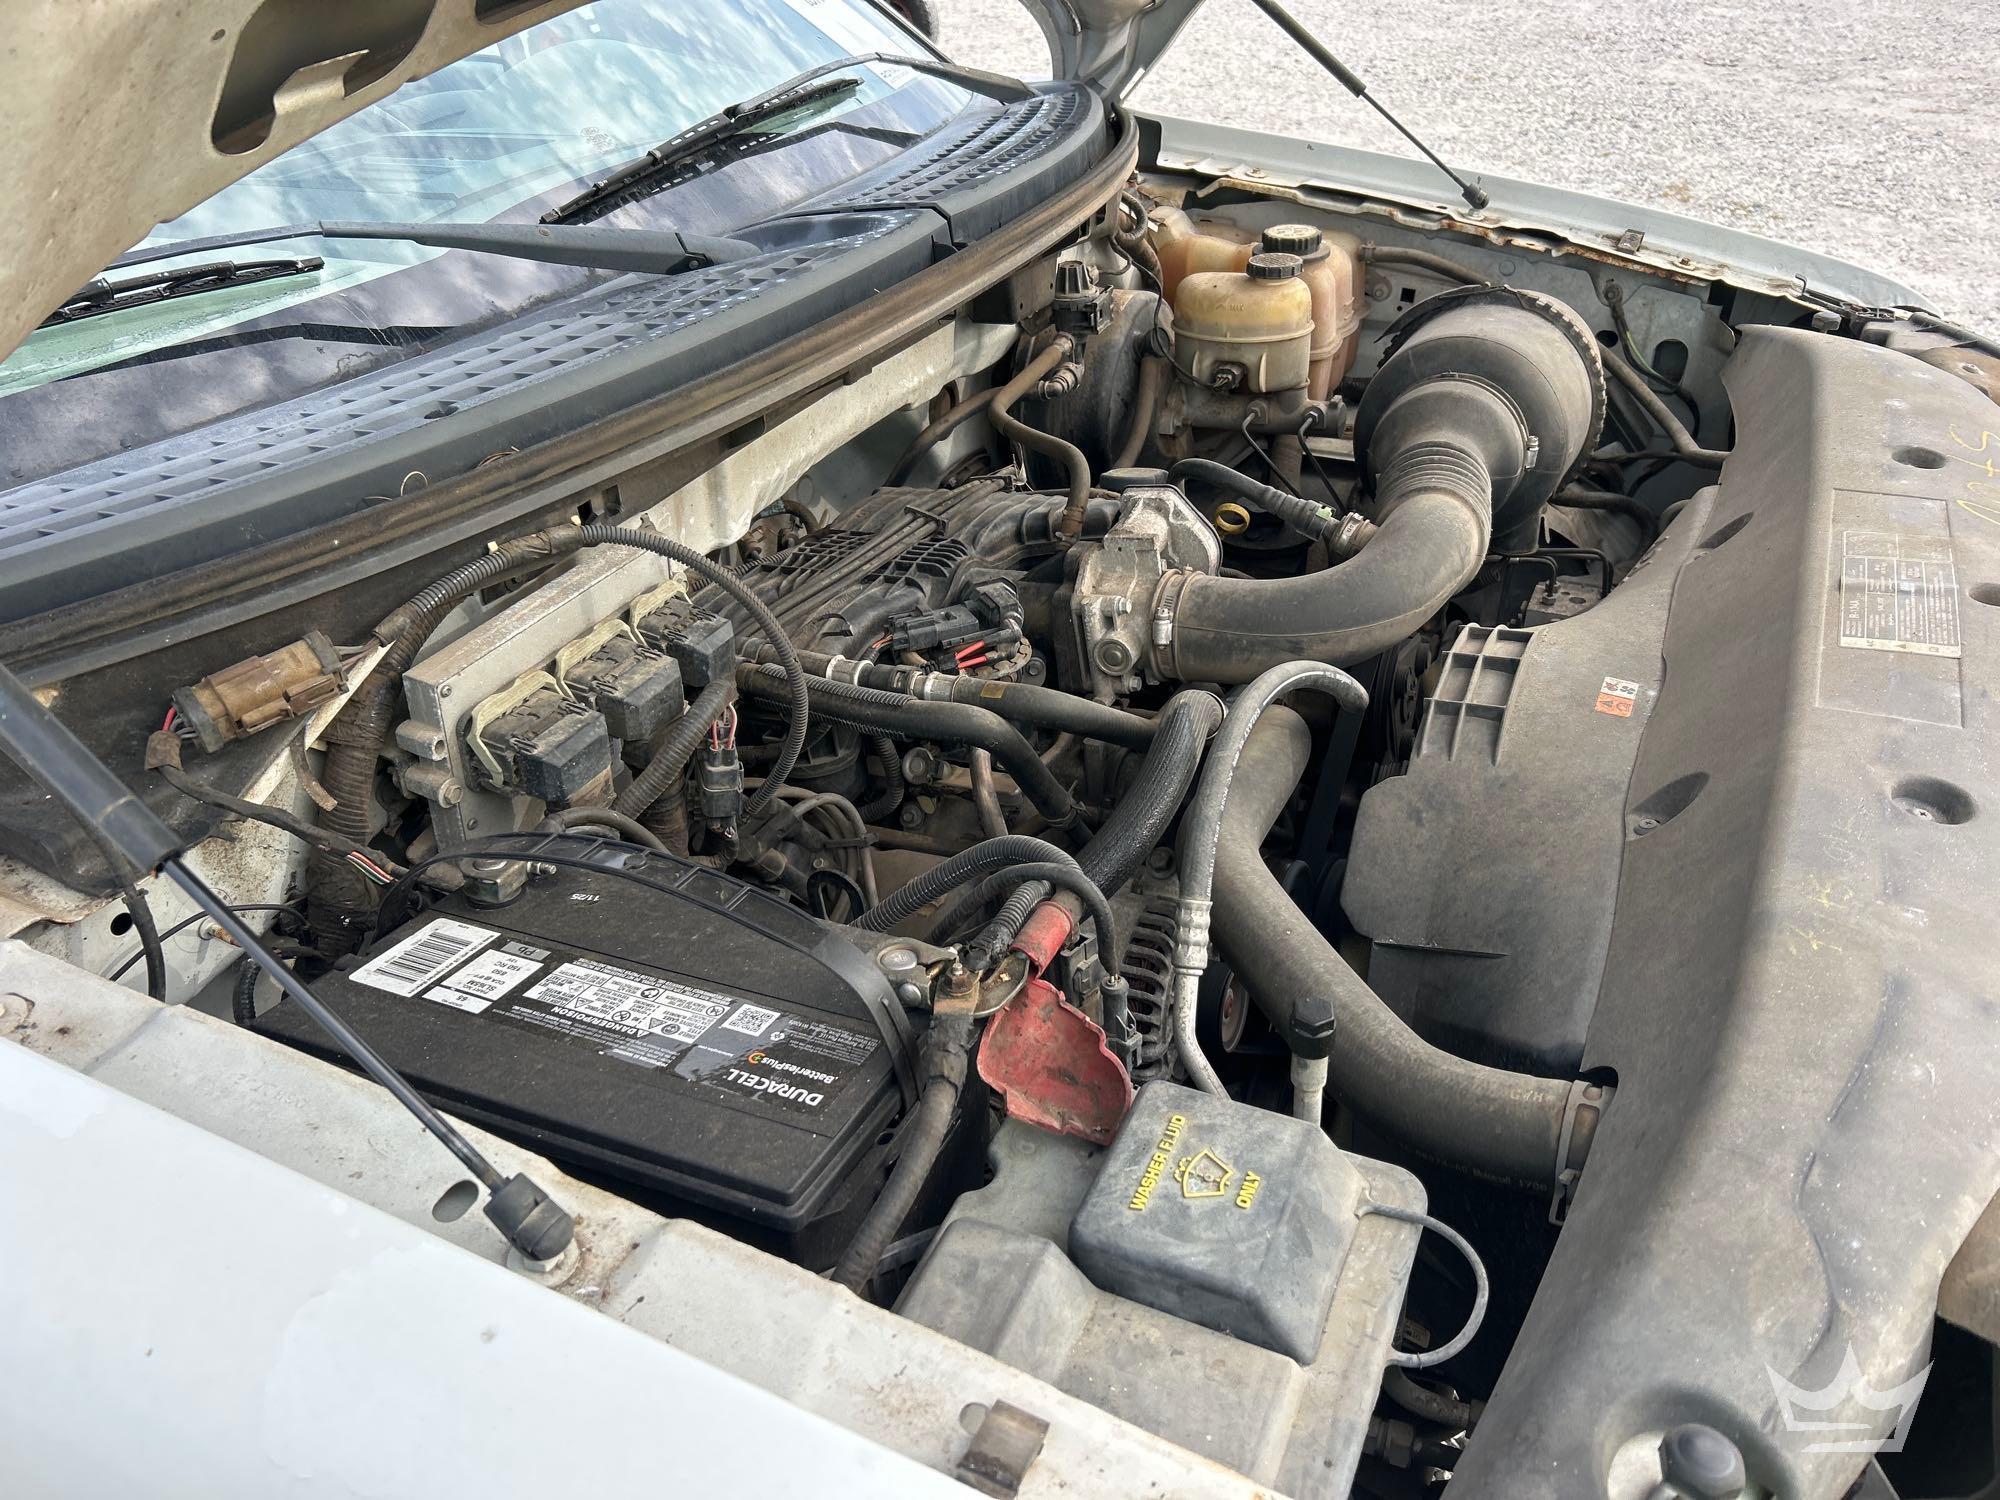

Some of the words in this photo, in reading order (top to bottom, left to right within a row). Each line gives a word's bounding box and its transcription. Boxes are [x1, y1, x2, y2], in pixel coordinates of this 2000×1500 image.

[570, 893, 600, 902] 11/25
[518, 945, 536, 955] Pb
[550, 1006, 638, 1034] DANGER/POISON
[727, 1068, 825, 1107] DURACELL
[1129, 1152, 1167, 1211] WASHER
[1158, 1114, 1186, 1153] FLUID
[1235, 1170, 1261, 1210] ONLY
